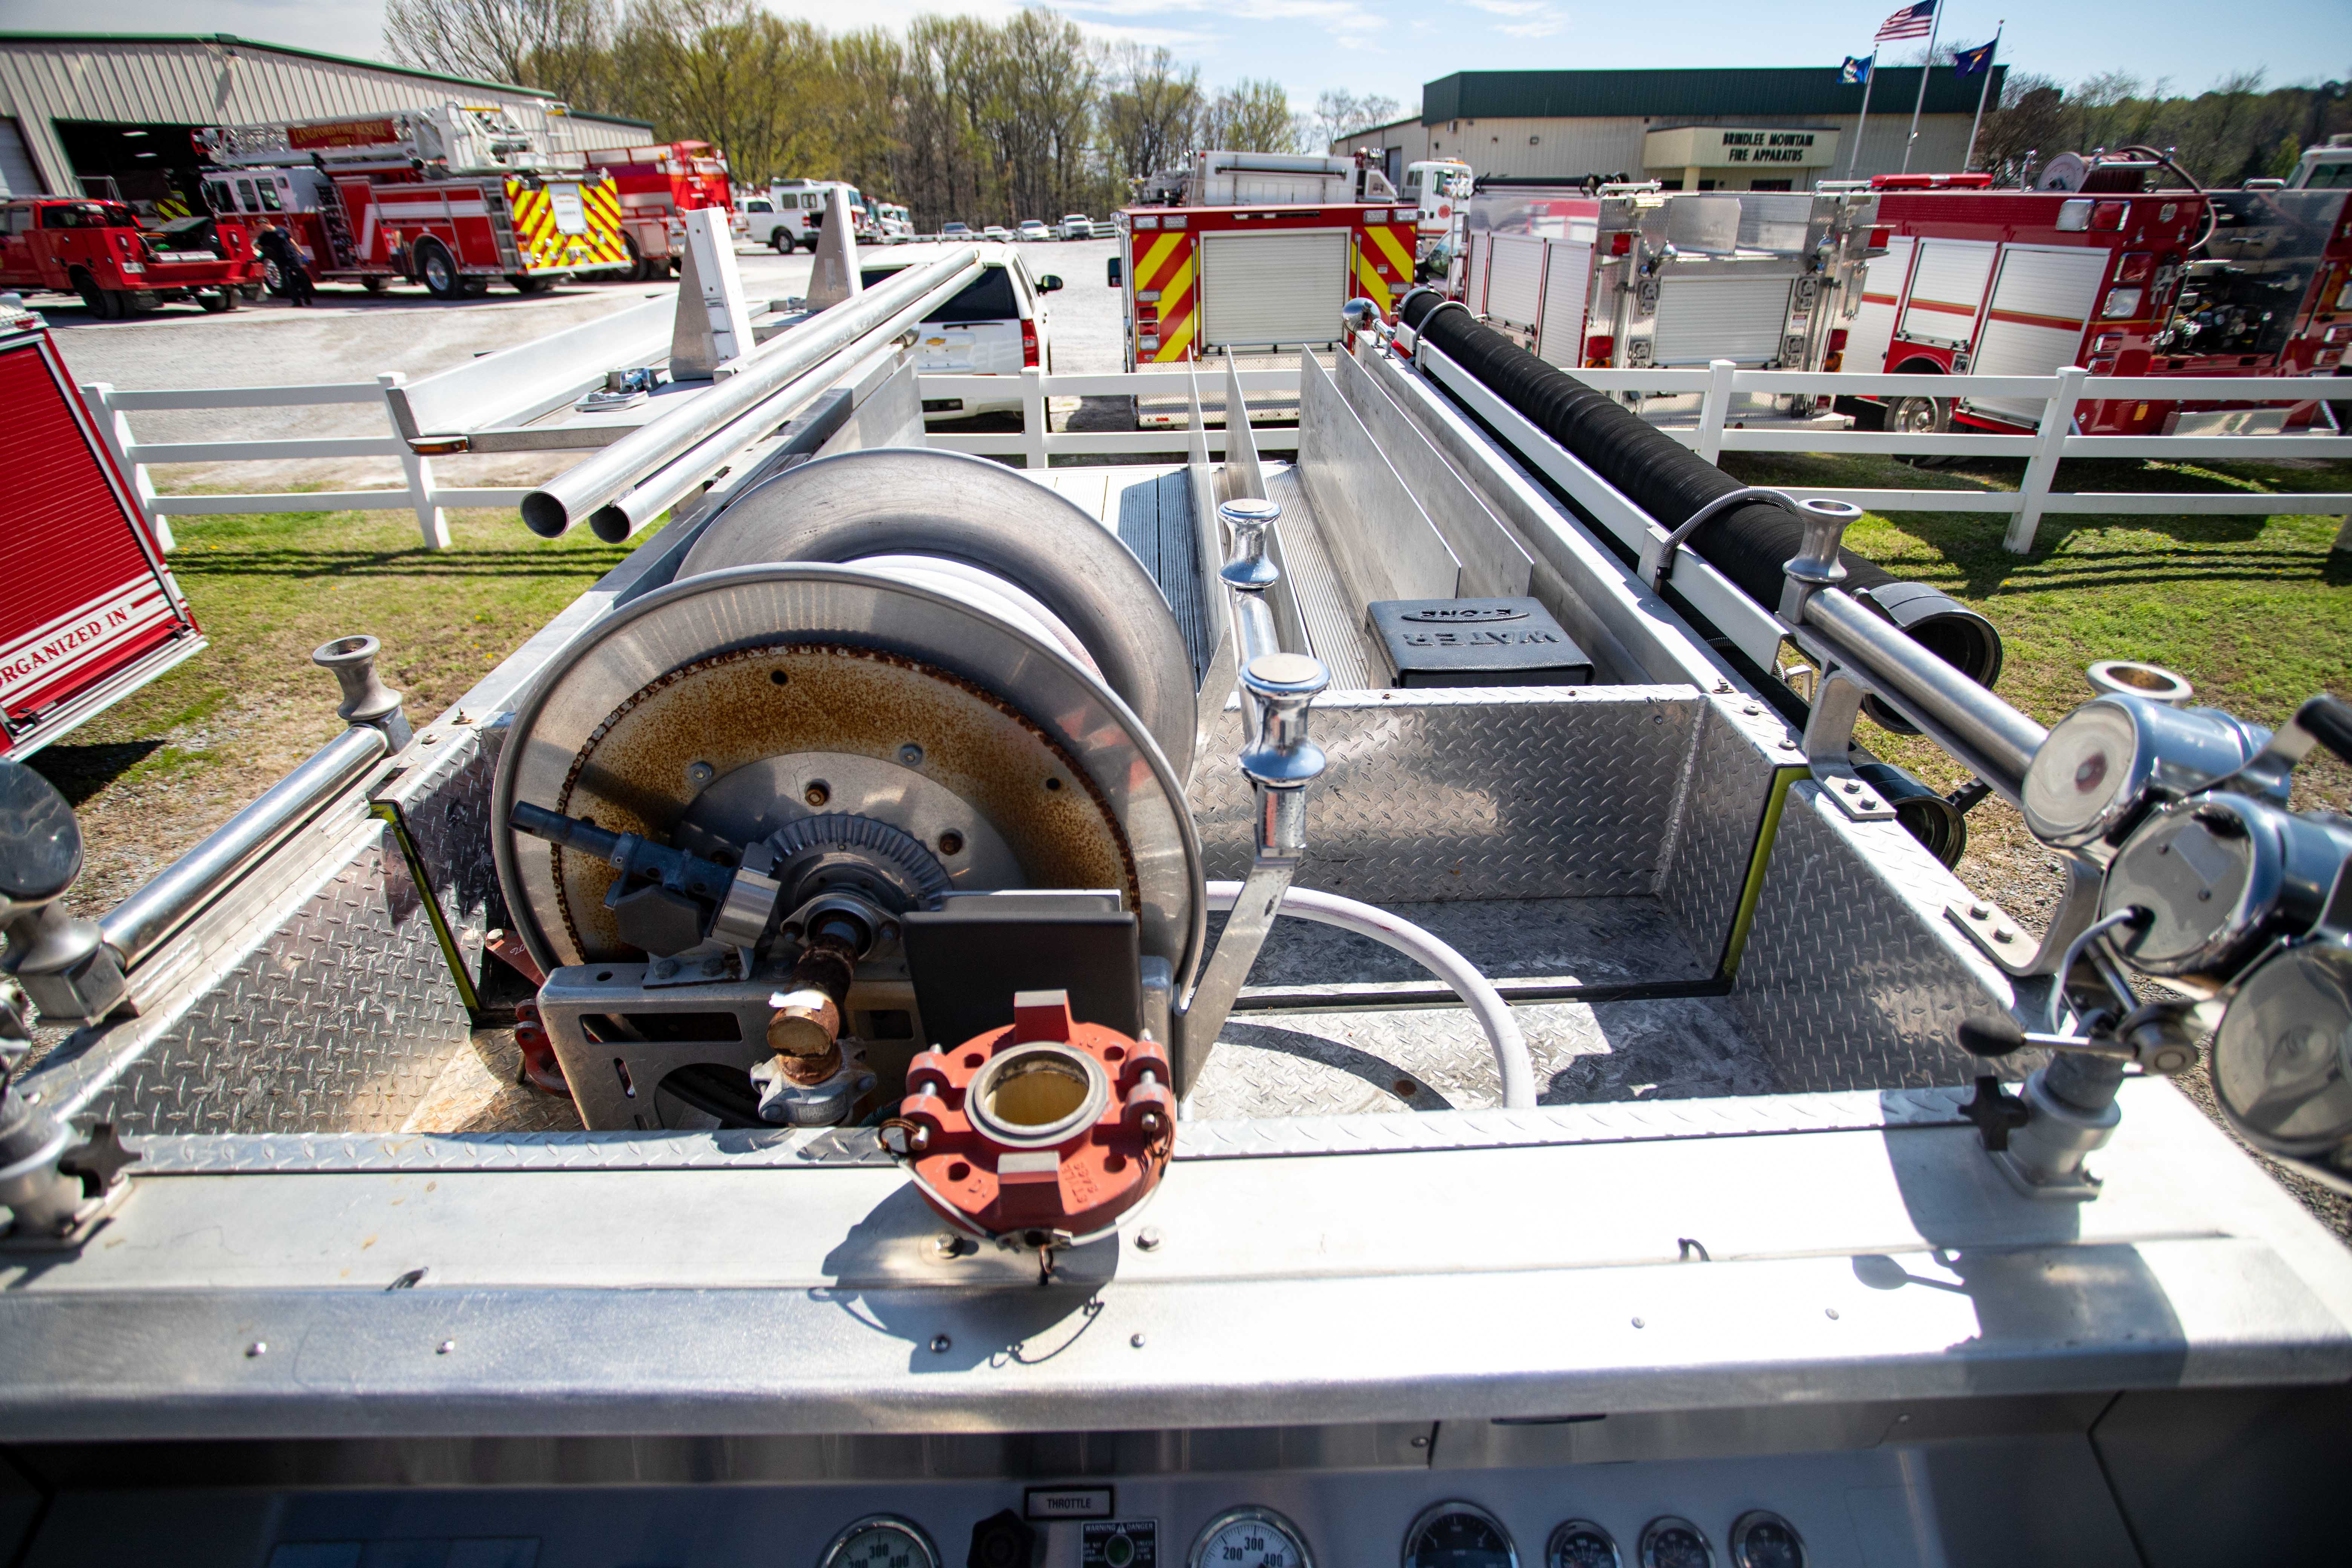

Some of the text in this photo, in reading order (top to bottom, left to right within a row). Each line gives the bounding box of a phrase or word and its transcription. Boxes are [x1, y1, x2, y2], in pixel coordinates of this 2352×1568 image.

[1722, 132, 1815, 147] BRINDLEE MOUNTAIN
[1729, 147, 1803, 162] FIRE APPARATUS
[105, 606, 129, 628] IN
[1402, 631, 1561, 647] WATER
[1047, 1498, 1091, 1509] THROTTLE
[1084, 1524, 1116, 1532] WARNING
[869, 1543, 889, 1559] 300
[1244, 1536, 1264, 1551] 300
[889, 1554, 909, 1568] 400
[1223, 1547, 1243, 1561] 200
[1263, 1553, 1283, 1568] 400
